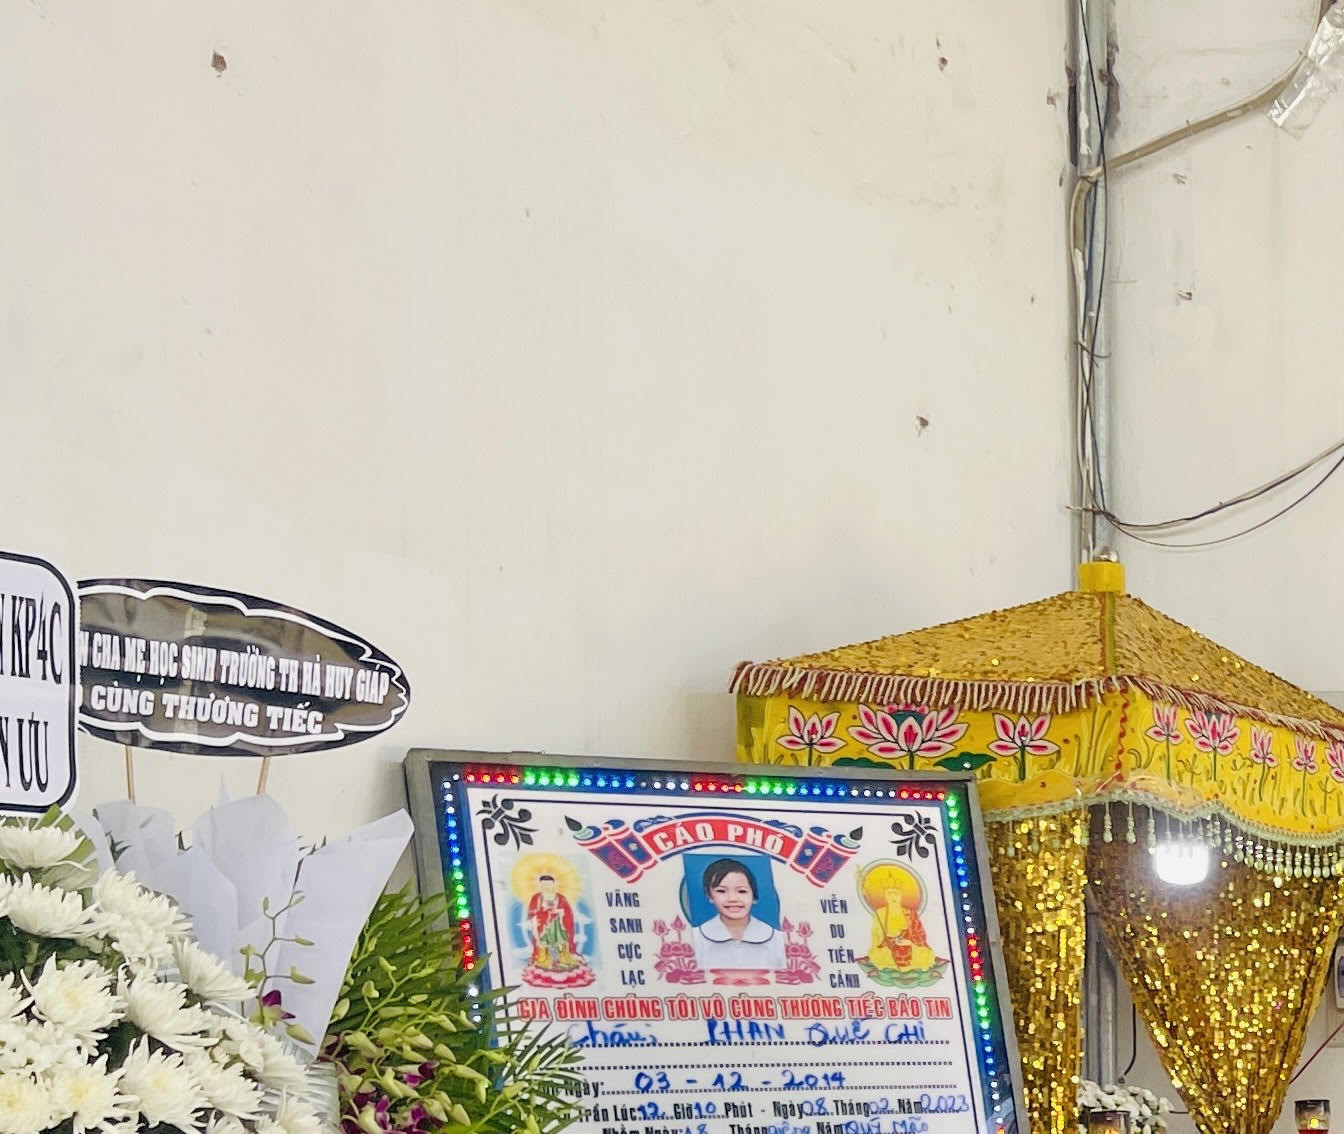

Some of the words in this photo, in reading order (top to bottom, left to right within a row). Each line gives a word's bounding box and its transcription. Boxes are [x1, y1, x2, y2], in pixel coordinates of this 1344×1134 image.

[11, 592, 62, 684] KP4C
[93, 633, 120, 671] CHA
[124, 637, 146, 683] MẸ
[150, 641, 179, 686] HỌC
[181, 645, 216, 682] SINH
[279, 658, 299, 692] TH
[301, 654, 321, 697] HÀ
[324, 664, 354, 700] HUY
[356, 663, 390, 705] GIÁP
[91, 680, 155, 716] CÙNG
[162, 692, 259, 728] THƯƠNG
[266, 701, 323, 734] TIẾC
[653, 822, 715, 852] CÁO
[727, 824, 785, 855] PHÓ
[606, 889, 640, 908] VÃNG
[820, 894, 848, 914] VIỄN
[610, 918, 643, 934] SANH
[830, 924, 845, 939] DU
[618, 944, 642, 962] CỰC
[828, 948, 854, 964] TIÊN
[621, 969, 645, 989] LẠC
[829, 971, 861, 989] CẢNH
[518, 999, 550, 1020] GIA
[556, 994, 598, 1020] ĐÌNH
[603, 994, 662, 1020] CHÚNG
[667, 997, 697, 1019] TÔI
[702, 994, 725, 1019] VÔ
[731, 993, 776, 1019] CÙNG
[780, 994, 843, 1019] THƯƠNG
[847, 992, 885, 1019] TIẾC
[888, 993, 922, 1019] BÁO
[924, 998, 952, 1019] TIN
[635, 1072, 671, 1092] 03
[712, 1072, 748, 1091] 12
[782, 1070, 846, 1088] 2014
[723, 1100, 754, 1119] Phút
[772, 1100, 804, 1120] Ngày
[833, 1098, 869, 1119] Tháng
[920, 1093, 969, 1113] 2023
